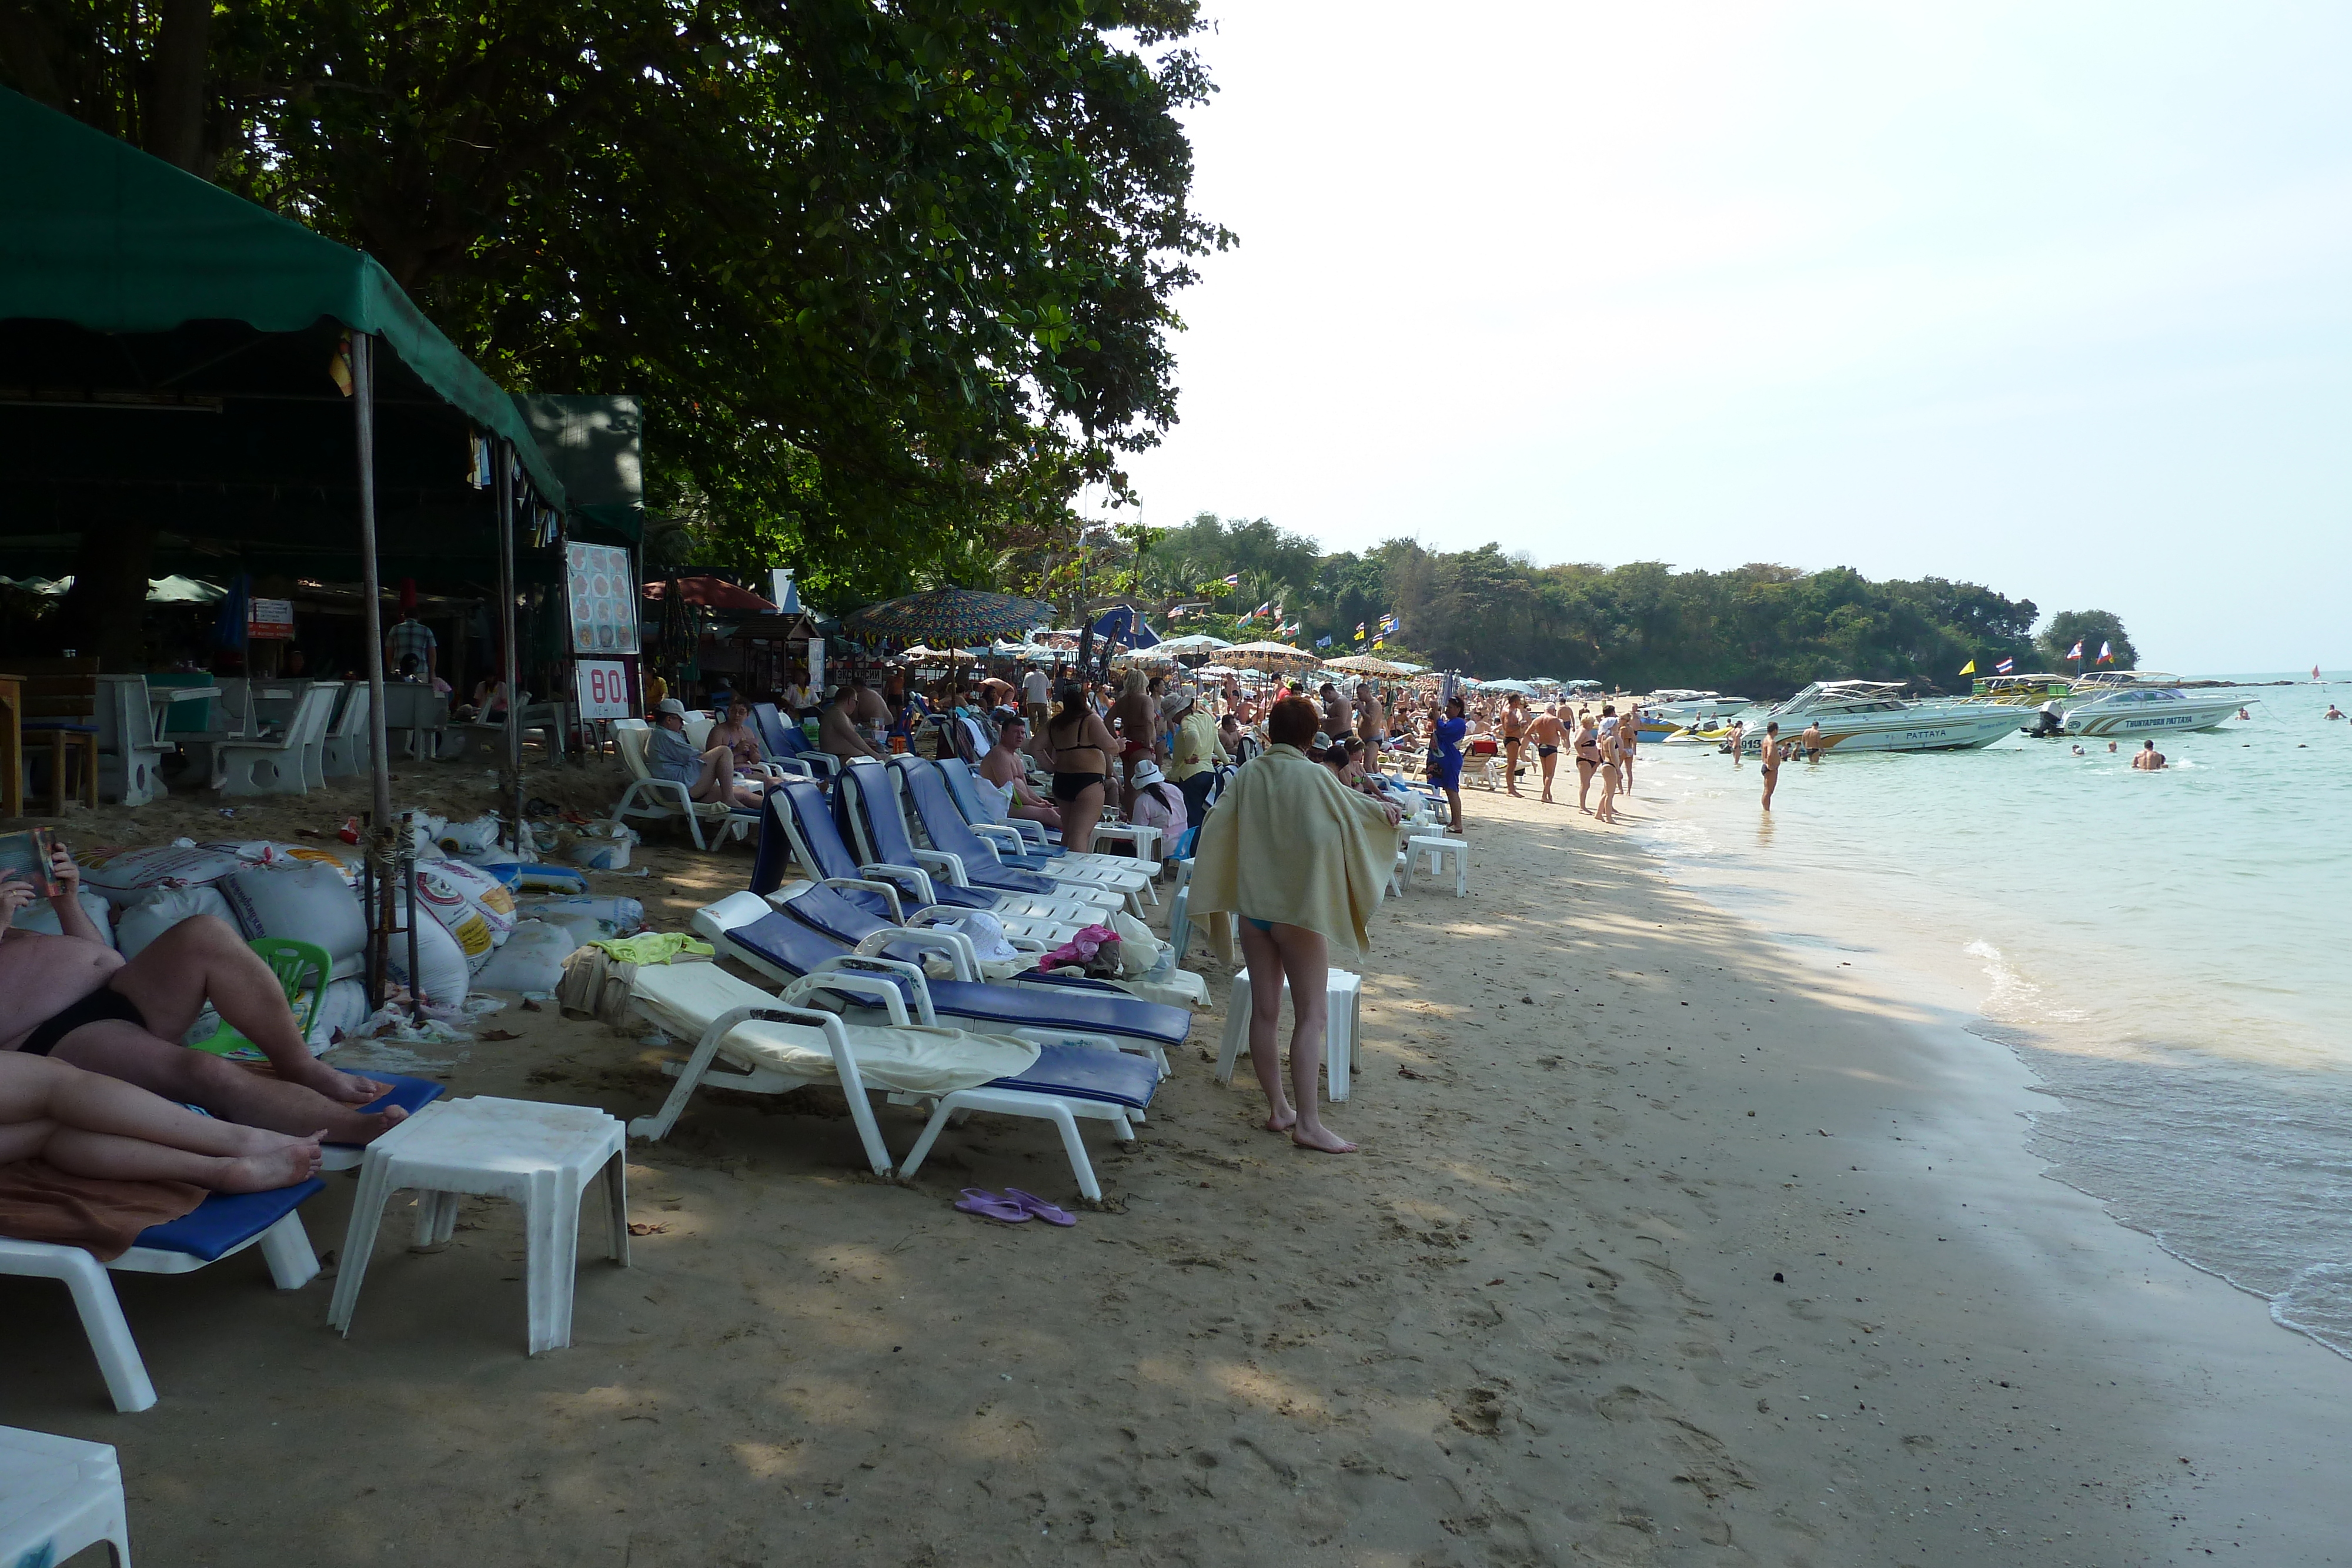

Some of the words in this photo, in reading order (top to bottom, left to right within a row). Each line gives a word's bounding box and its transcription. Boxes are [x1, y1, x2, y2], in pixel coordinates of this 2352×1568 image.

[837, 670, 880, 679] ЭКСУРСИИ
[2166, 716, 2192, 725] PATTAYA
[1906, 730, 1946, 740] PATTAYA
